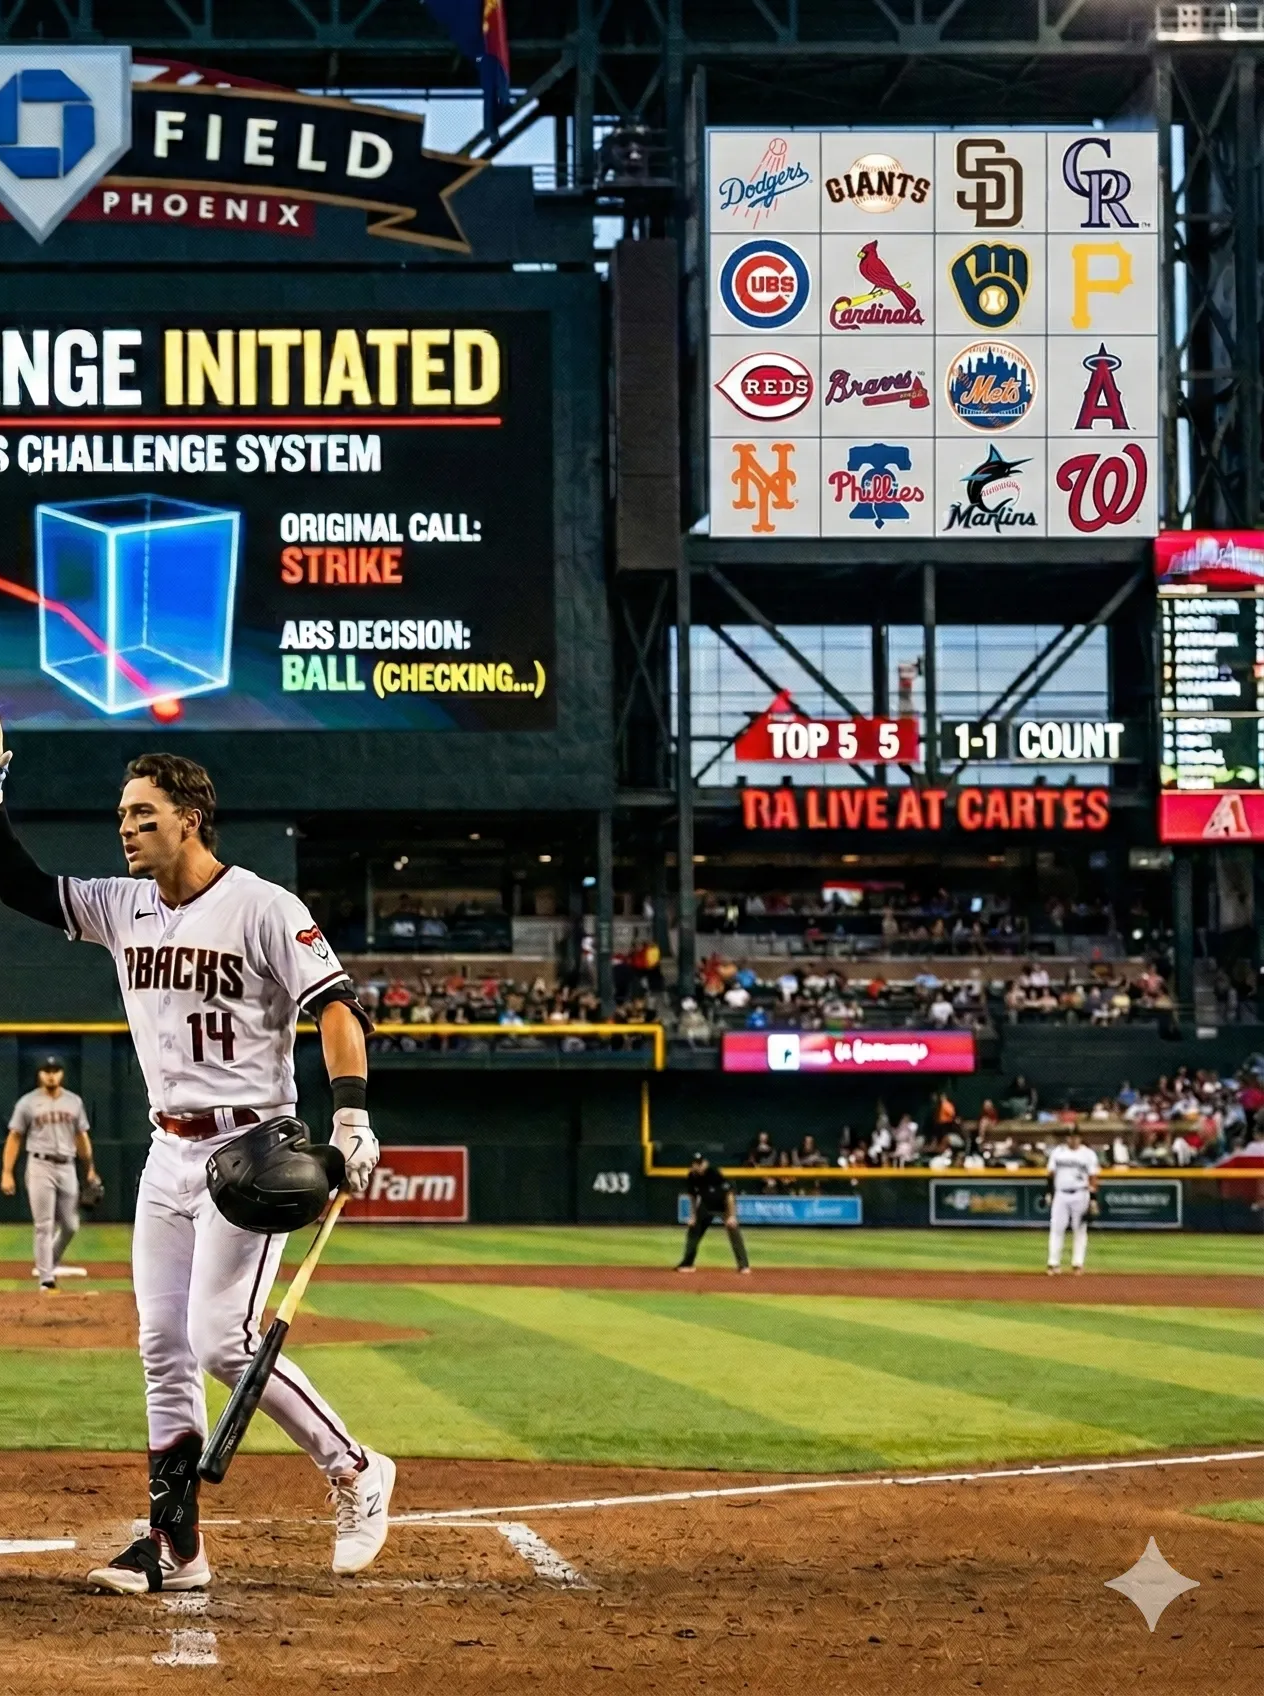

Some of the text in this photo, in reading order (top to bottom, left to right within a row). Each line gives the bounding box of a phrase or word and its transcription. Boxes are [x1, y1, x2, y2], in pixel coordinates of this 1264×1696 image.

[153, 110, 394, 179] FIELD
[719, 162, 810, 210] Dodgers
[825, 171, 931, 204] GIANTS
[102, 191, 300, 228] PHOENIX
[1071, 242, 1133, 329] P
[164, 328, 502, 406] INITIATED
[744, 379, 809, 395] REDS
[960, 374, 1021, 404] Mets
[18, 434, 227, 474] CHALLENGE
[235, 433, 381, 473] SYSTEM
[828, 471, 925, 502] Phillies
[1056, 443, 1148, 532] W
[280, 512, 482, 543] ORIGINAL CALL:
[281, 546, 403, 585] STRIKE
[279, 620, 471, 650] ABS DECISION:
[282, 654, 546, 699] BALL (CHECKING...)
[767, 723, 899, 759] TOP 5 5
[955, 722, 1125, 759] 1-1 COUNT
[806, 790, 888, 828] LIVE
[896, 790, 947, 828] AT
[957, 789, 1110, 829] CARTES
[186, 1011, 236, 1063] 14
[370, 1167, 456, 1202] Farm
